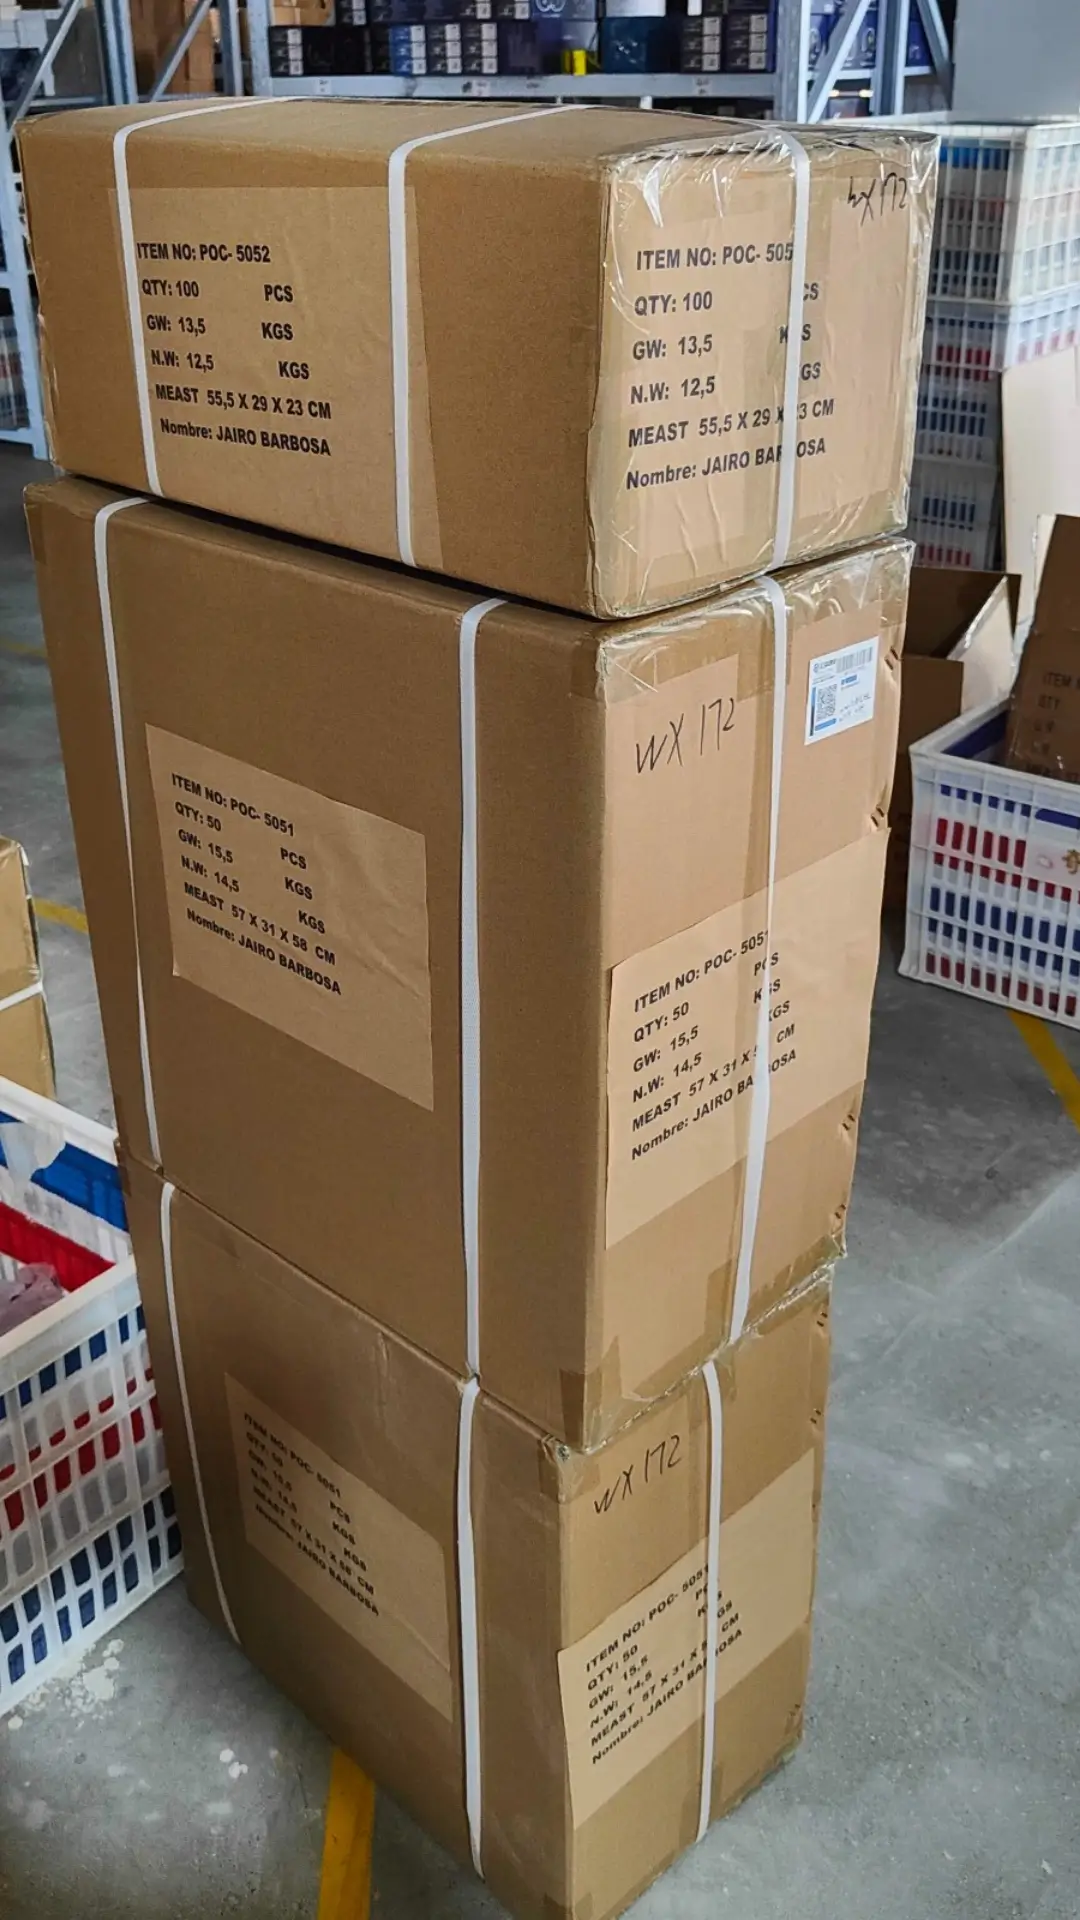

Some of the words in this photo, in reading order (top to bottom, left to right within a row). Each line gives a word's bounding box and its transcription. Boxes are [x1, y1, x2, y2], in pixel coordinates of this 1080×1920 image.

[137, 243, 168, 260] ITEM
[173, 244, 196, 261] NO:
[200, 245, 232, 261] POC-
[236, 245, 270, 263] 5052
[636, 249, 680, 270] ITEM
[687, 247, 716, 267] NO:
[722, 245, 760, 265] POC-
[766, 242, 794, 262] 505
[142, 279, 172, 296] QTY:
[176, 281, 199, 297] 100
[264, 284, 293, 302] PCS
[634, 294, 676, 316] QTY:
[683, 291, 713, 311] 100
[147, 315, 171, 331] GW:
[178, 317, 206, 337] 13,5
[261, 322, 293, 340] KGS
[632, 339, 666, 360] GW:
[678, 334, 713, 357] 13,5
[779, 324, 811, 344] KS
[151, 350, 179, 367] N.W:
[187, 353, 214, 373] 12,5
[278, 361, 309, 379] KGS
[631, 384, 669, 404] N.W:
[681, 376, 715, 399] 12,5
[800, 362, 821, 381] GS
[155, 384, 198, 403] MEAST
[207, 390, 234, 411] 55,5
[239, 393, 248, 409] X
[252, 394, 267, 411] 29
[272, 397, 282, 413] X
[286, 399, 303, 415] 23
[308, 402, 331, 419] CM
[628, 421, 688, 448] MEAST
[699, 414, 732, 437] 55,5
[737, 411, 748, 430] X
[752, 409, 770, 427] 29
[796, 402, 807, 420] 3
[812, 399, 834, 417] CM
[160, 418, 212, 439] Nombre:
[216, 426, 256, 445] JAIRO
[260, 431, 331, 456] BARBOSA
[626, 464, 696, 490] Nombre:
[702, 451, 749, 476] JAIRO
[700, 698, 735, 756] 172
[172, 774, 201, 796] ITEM
[205, 787, 227, 807] NO:
[230, 798, 261, 820] POC-
[264, 813, 294, 836] 5051
[175, 801, 203, 824] QTY:
[207, 815, 221, 831] 50
[280, 848, 306, 869] PCS
[178, 829, 201, 849] GW:
[208, 843, 233, 864] 15,5
[284, 877, 312, 900] KGS
[181, 856, 207, 878] N.W:
[214, 872, 239, 893] 14,5
[298, 910, 325, 934] KGS
[184, 882, 224, 910] MEAST
[231, 906, 245, 921] 57
[250, 913, 258, 928] X
[261, 920, 275, 937] 31
[280, 928, 289, 944] X
[293, 935, 307, 951] 58
[315, 946, 335, 965] CM
[187, 908, 234, 941] Nombre:
[238, 934, 275, 961] JAIRO
[279, 954, 341, 995] BARBOSA
[635, 982, 671, 1012] ITEM
[675, 969, 700, 990] NO:
[704, 948, 737, 974] POC-
[634, 1015, 668, 1043] QTY:
[672, 1002, 689, 1022] 50
[633, 1050, 661, 1072] GW:
[670, 1025, 699, 1051] 15,5
[632, 1076, 664, 1102] N.W:
[673, 1052, 702, 1078] 14,5
[632, 1092, 681, 1132] MEAST
[689, 1078, 704, 1097] 57
[709, 1069, 719, 1087] X
[722, 1059, 737, 1077] 31
[741, 1050, 750, 1068] X
[777, 1023, 795, 1043] CM
[632, 1118, 688, 1160] Nombre:
[693, 1088, 733, 1122] JAIRO
[737, 1049, 796, 1092] BAOSA
[644, 1434, 682, 1484] 172
[585, 1640, 618, 1672] ITEM
[623, 1619, 645, 1642] NO:
[648, 1593, 678, 1620] POC-
[716, 1600, 732, 1618] GS
[587, 1662, 619, 1691] QTY:
[623, 1645, 638, 1662] 50
[591, 1703, 635, 1746] MEAST
[642, 1683, 656, 1702] 57
[660, 1677, 668, 1687] X
[672, 1660, 685, 1676] 31
[689, 1649, 698, 1660] X
[721, 1613, 739, 1632] CM
[588, 1685, 614, 1710] GW:
